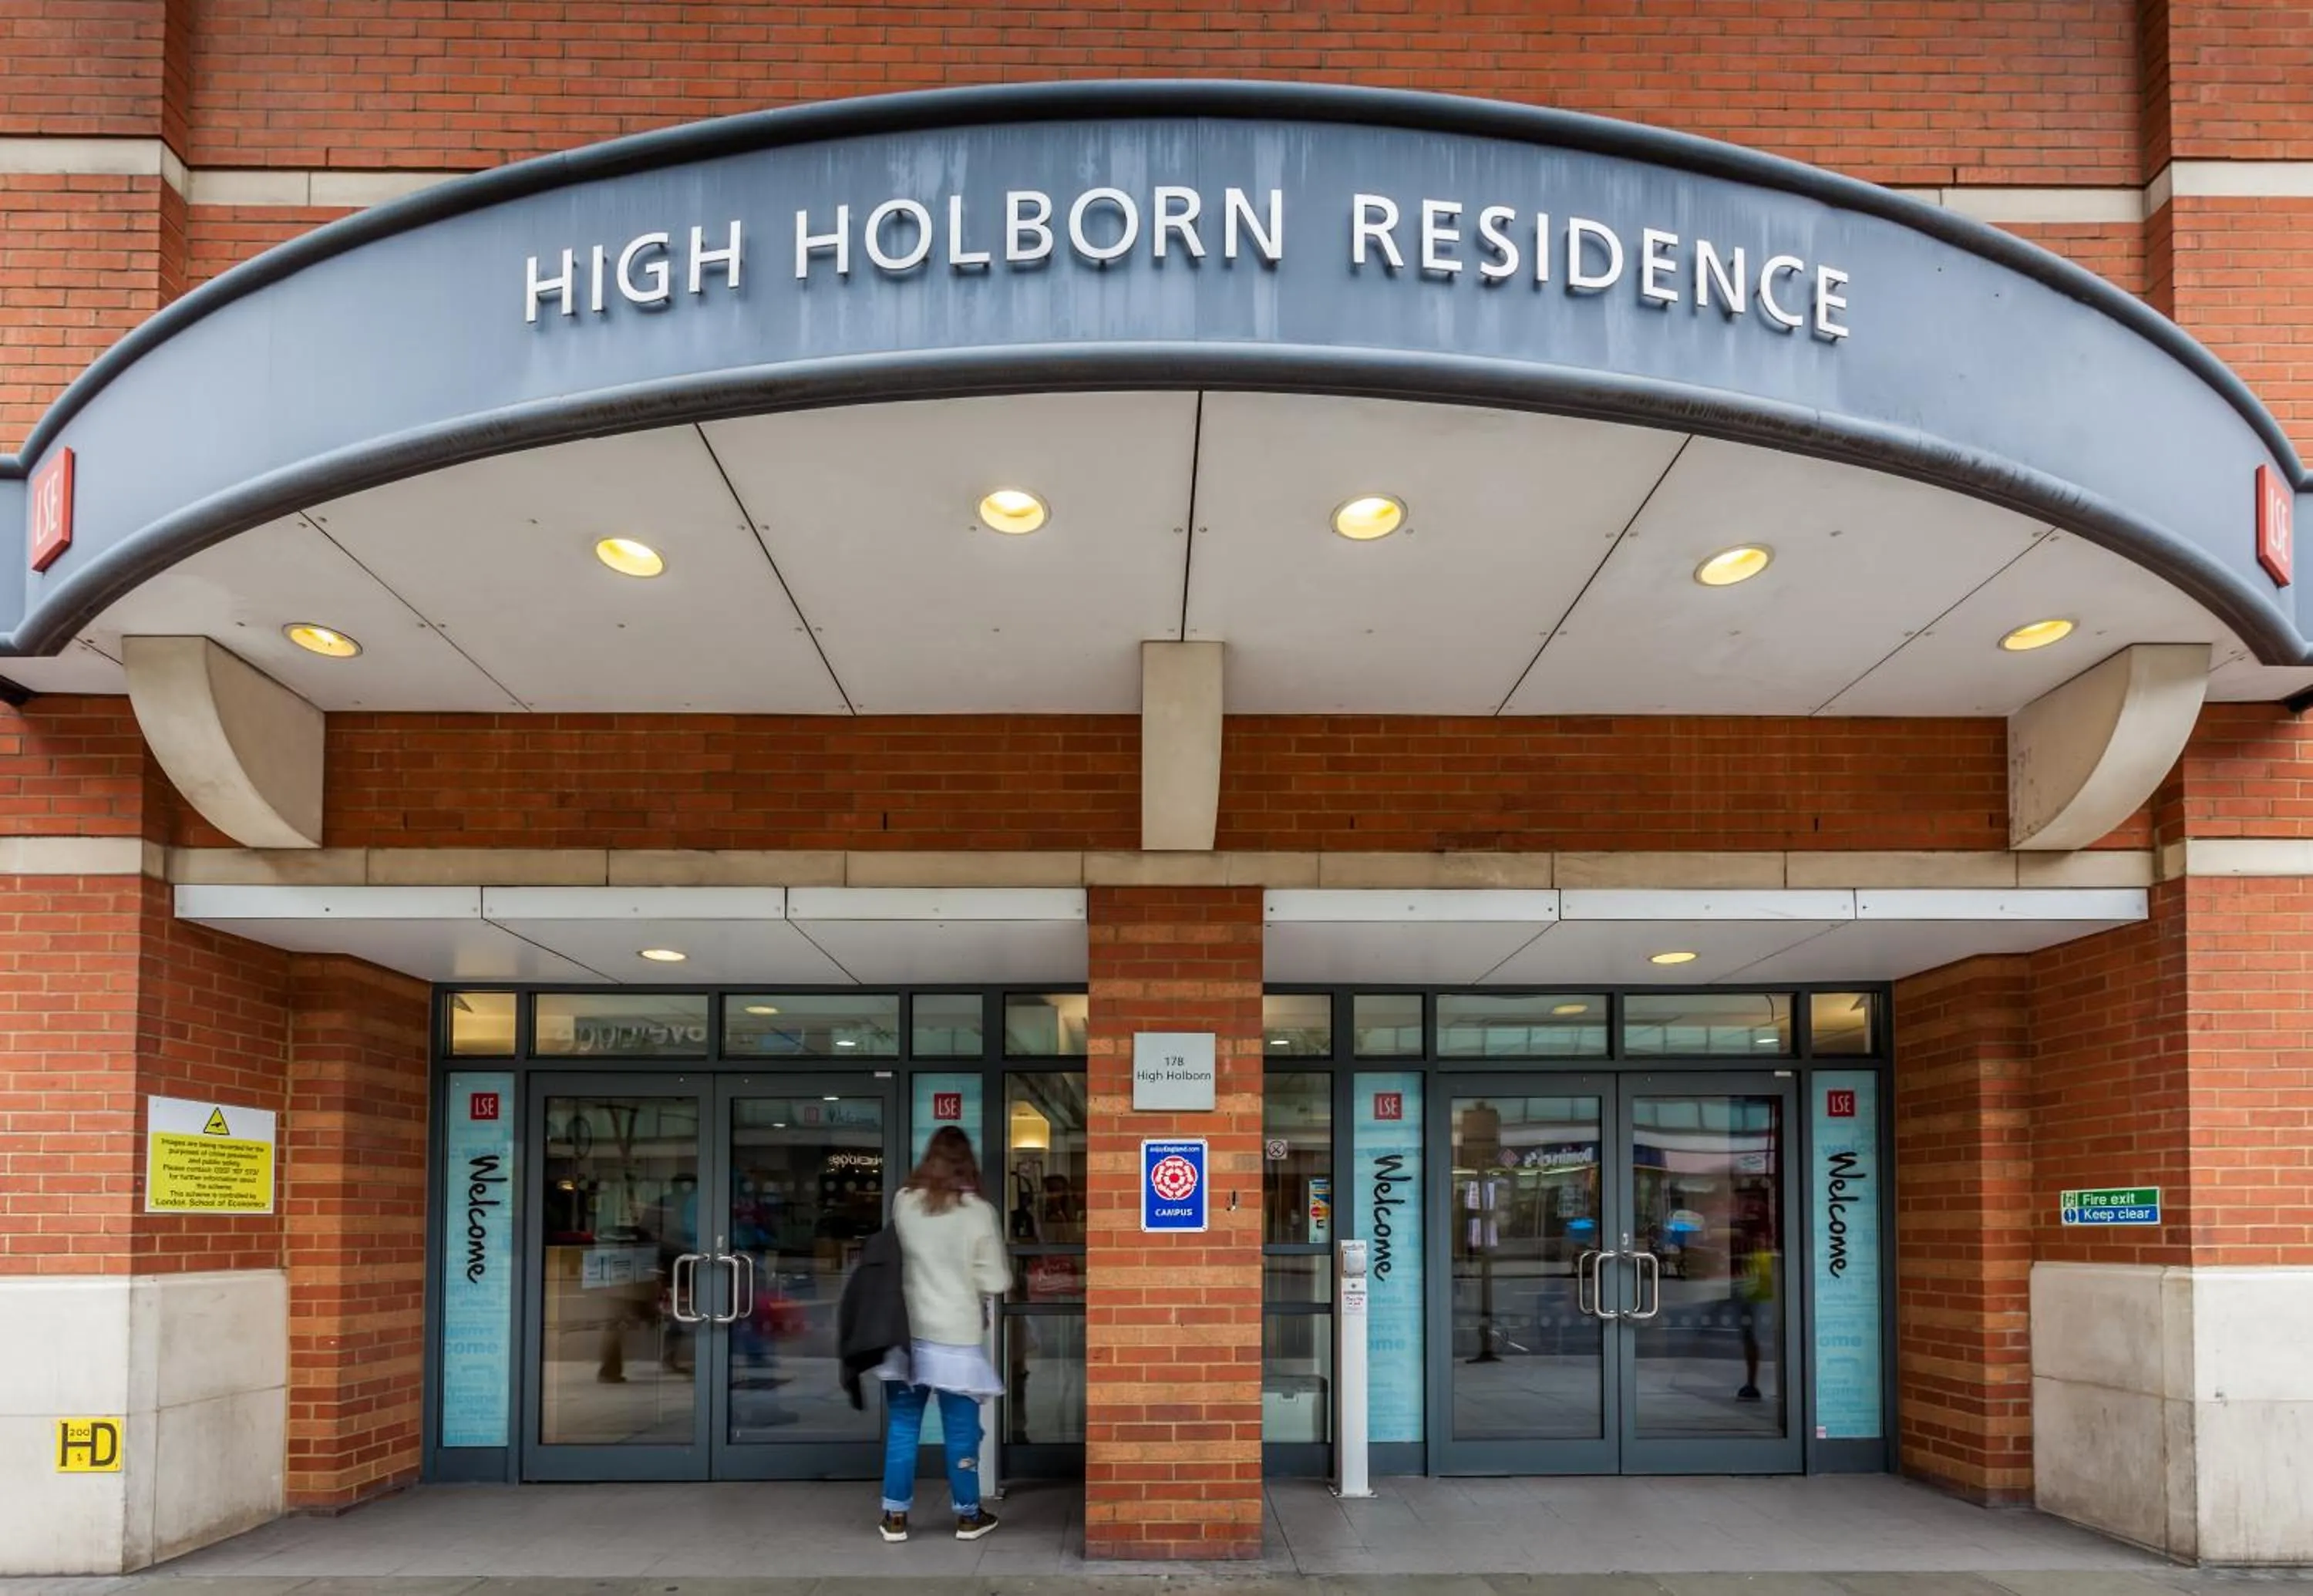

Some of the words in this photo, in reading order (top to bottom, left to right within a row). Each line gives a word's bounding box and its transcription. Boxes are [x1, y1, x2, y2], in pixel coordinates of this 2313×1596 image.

[525, 220, 742, 322] HIGH
[795, 187, 1283, 279] HOLBORN
[1352, 194, 1849, 339] RESIDENCE
[36, 470, 59, 546] LSE
[2269, 487, 2288, 563] LSE
[1164, 1056, 1184, 1066] 178
[1136, 1070, 1163, 1082] High
[1167, 1070, 1211, 1080] Holborn
[475, 1097, 494, 1116] LSE
[938, 1097, 957, 1116] LSE
[1379, 1097, 1398, 1116] LSE
[1831, 1095, 1850, 1113] LSE
[189, 1198, 215, 1207] School
[2082, 1193, 2107, 1205] Fire
[2110, 1192, 2136, 1204] exit
[466, 1155, 508, 1284] Welcome
[1154, 1208, 1194, 1217] CAMPUS
[1373, 1154, 1412, 1281] Welcome
[1827, 1151, 1867, 1278] Welcome
[2084, 1208, 2115, 1222] Keep
[2118, 1207, 2150, 1219] clear
[61, 1423, 117, 1466] HD
